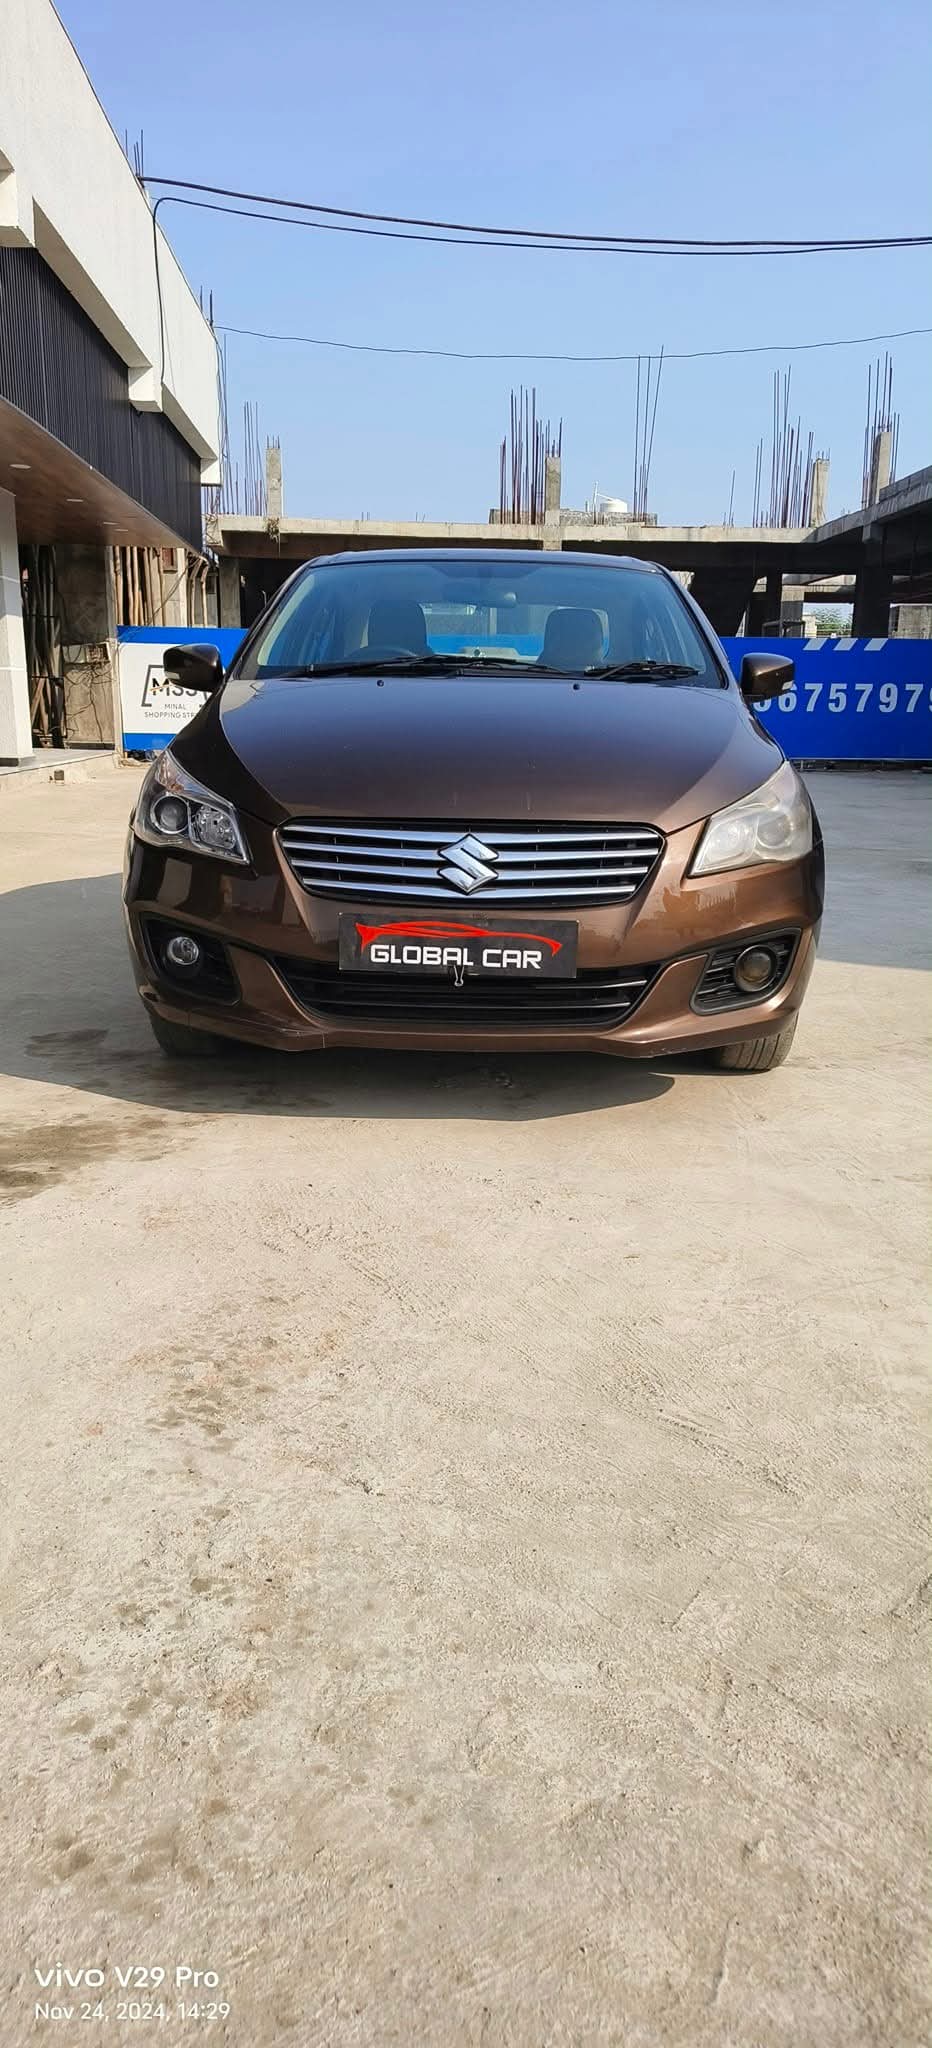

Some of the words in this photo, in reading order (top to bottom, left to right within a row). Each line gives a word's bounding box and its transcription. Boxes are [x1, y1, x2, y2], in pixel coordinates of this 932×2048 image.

[753, 683, 932, 713] 675797
[144, 711, 181, 719] SHOPPING
[182, 711, 198, 719] STR
[370, 944, 474, 966] GLOBAL
[482, 949, 543, 969] CAR
